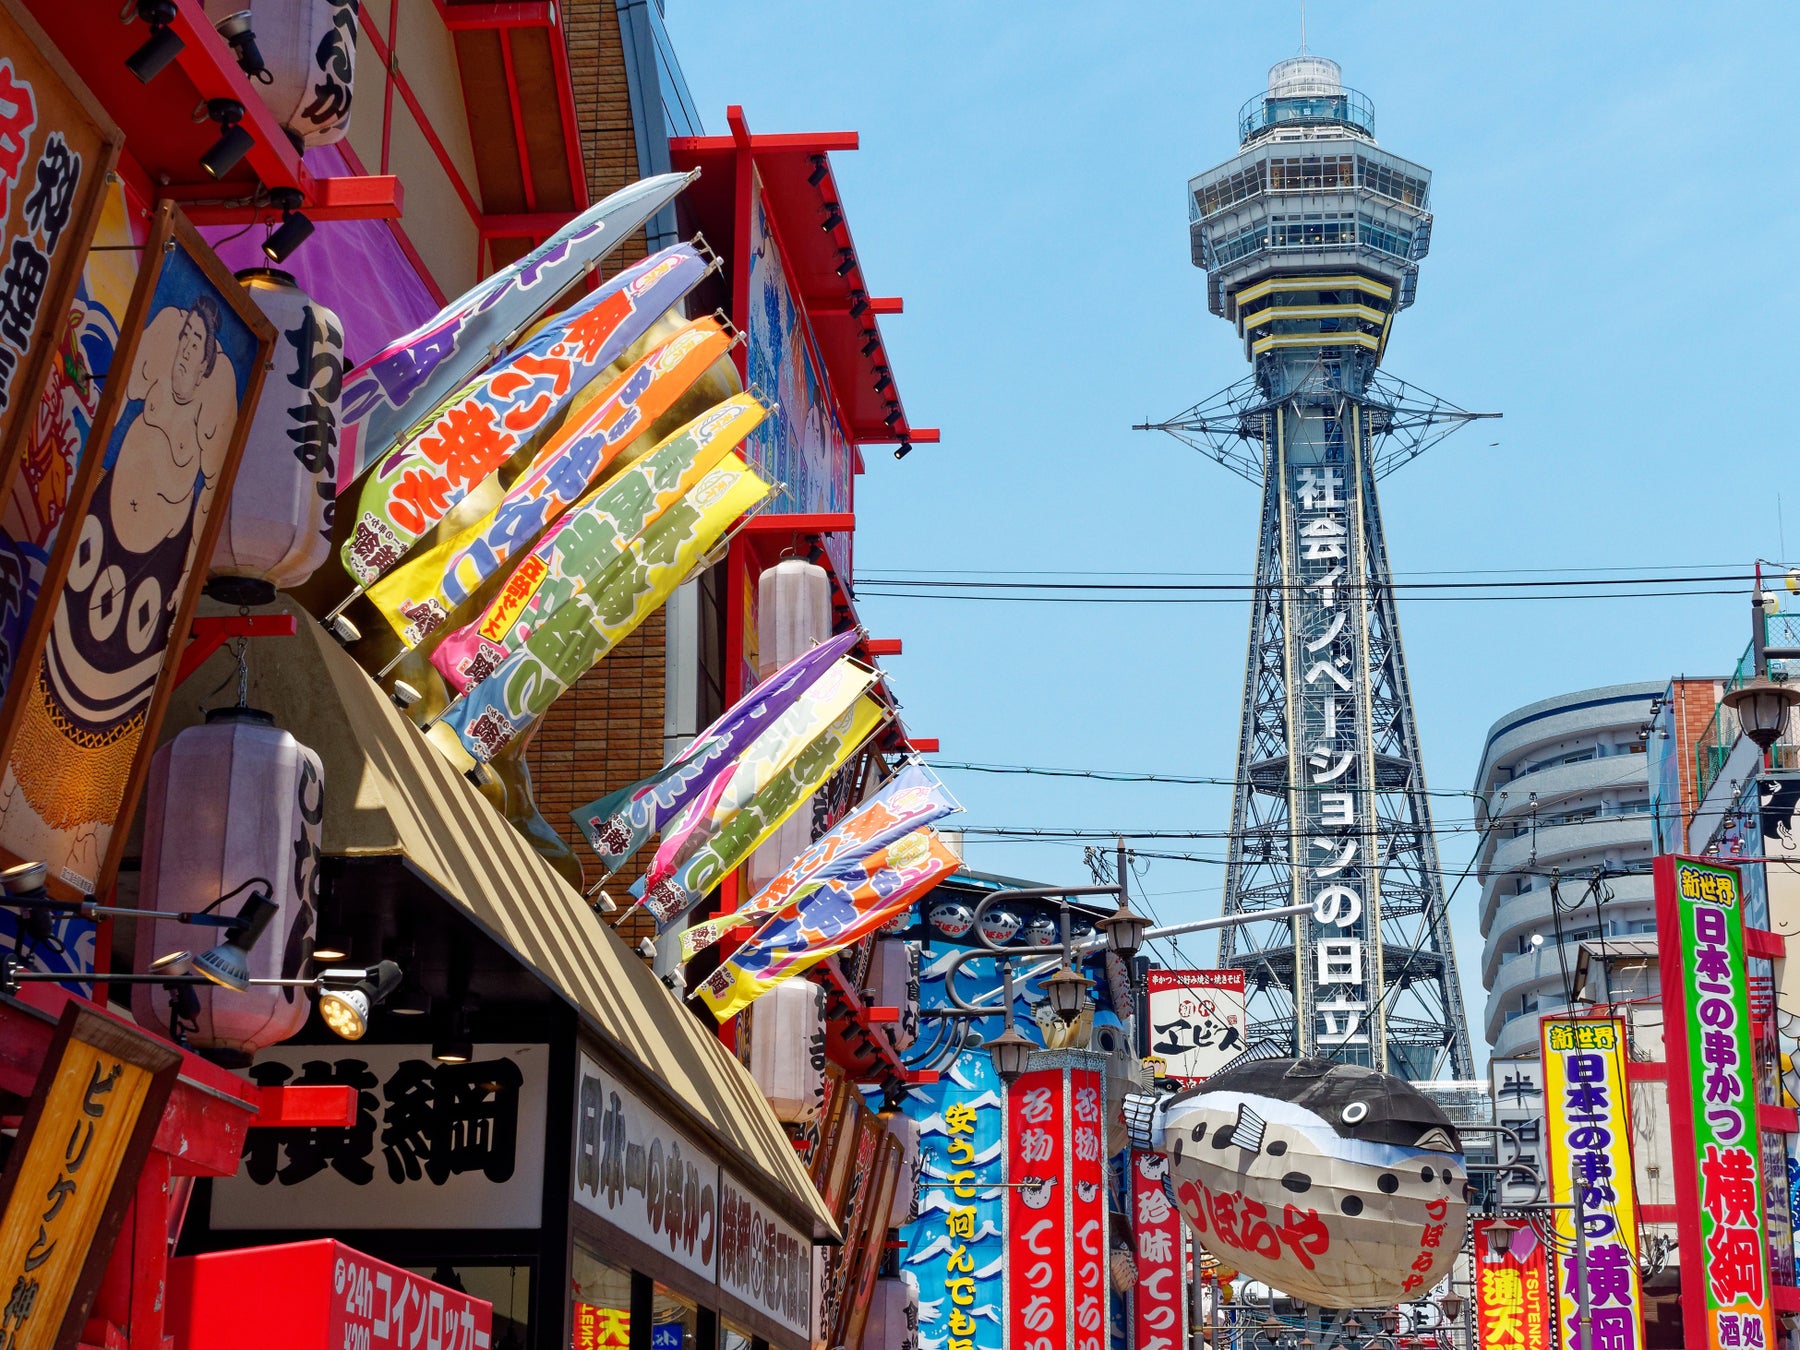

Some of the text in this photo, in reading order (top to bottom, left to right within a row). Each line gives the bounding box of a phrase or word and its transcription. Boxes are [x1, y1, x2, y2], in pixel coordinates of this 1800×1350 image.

[1297, 467, 1367, 1047] 社会イノベーションの日立
[1681, 868, 1734, 906] 新世界
[1550, 1025, 1617, 1051] 新世界
[1695, 907, 1742, 1142] 日本一の串かつ
[1020, 1087, 1053, 1163] 名物
[1075, 1087, 1098, 1163] 名物
[1567, 1053, 1616, 1238] 日本一の串かつ
[577, 1071, 714, 1266] 日本一の串かつ
[1178, 1180, 1329, 1270] づぼらや
[1401, 1198, 1449, 1293] づぼらや
[1702, 1146, 1765, 1306] 横綱
[346, 1262, 374, 1320] 24h
[374, 1271, 490, 1350] コインロッカー
[1482, 1268, 1524, 1350] 通天
[1719, 1314, 1764, 1348] 酒処
